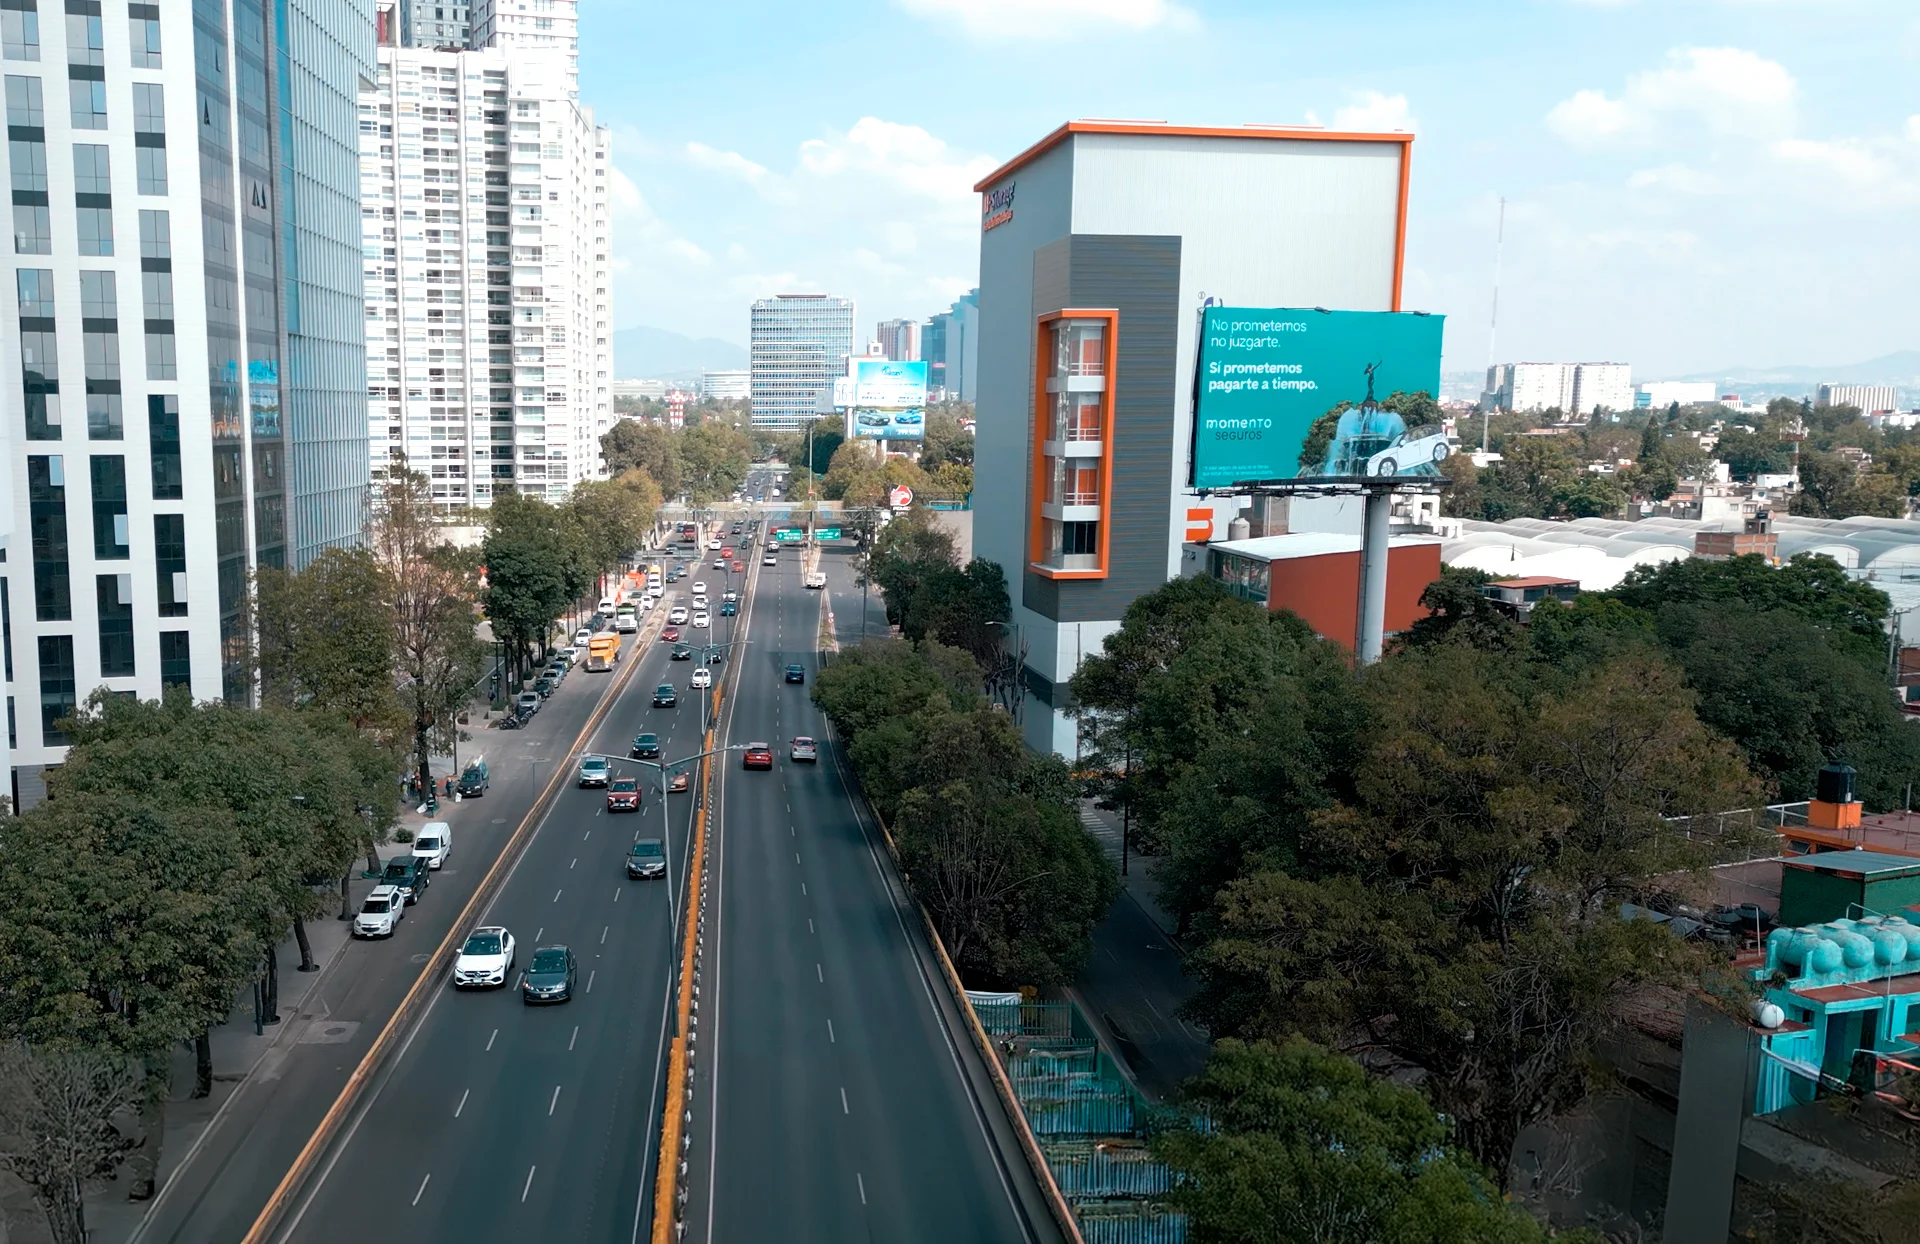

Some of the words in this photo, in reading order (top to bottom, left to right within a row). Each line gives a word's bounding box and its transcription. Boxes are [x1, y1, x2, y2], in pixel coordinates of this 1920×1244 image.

[1211, 319, 1229, 331] No
[1231, 320, 1307, 334] prometemos
[1211, 337, 1227, 347] no
[1228, 334, 1281, 351] juzgarte.
[1209, 360, 1222, 374] Sí
[1223, 362, 1303, 377] prometemos
[1208, 378, 1259, 393] pagarte
[1261, 381, 1269, 390] a
[1272, 376, 1318, 393] tiempo.
